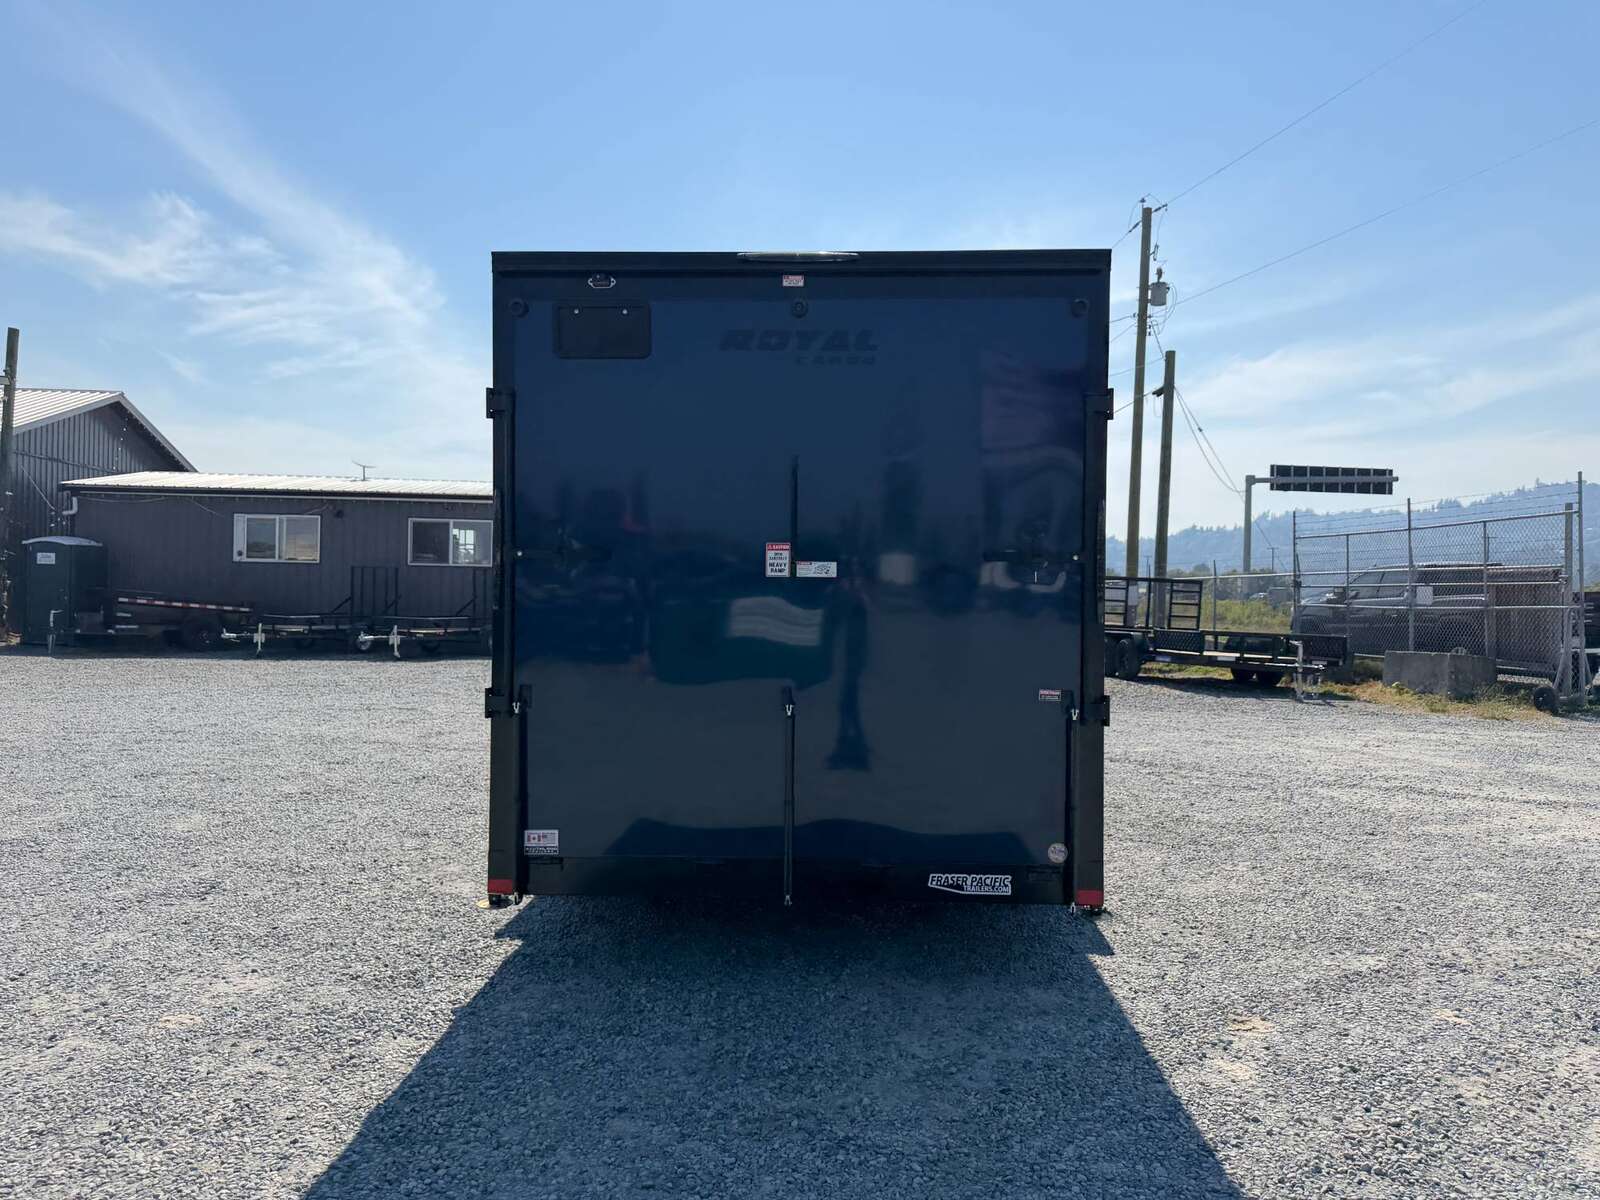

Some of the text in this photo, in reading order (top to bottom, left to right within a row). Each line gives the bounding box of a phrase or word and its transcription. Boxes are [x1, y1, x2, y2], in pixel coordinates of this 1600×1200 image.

[720, 329, 879, 351] ROYAL
[929, 875, 1010, 887] FRASER PACIFIC
[963, 885, 1009, 893] TRAILERS.COM
